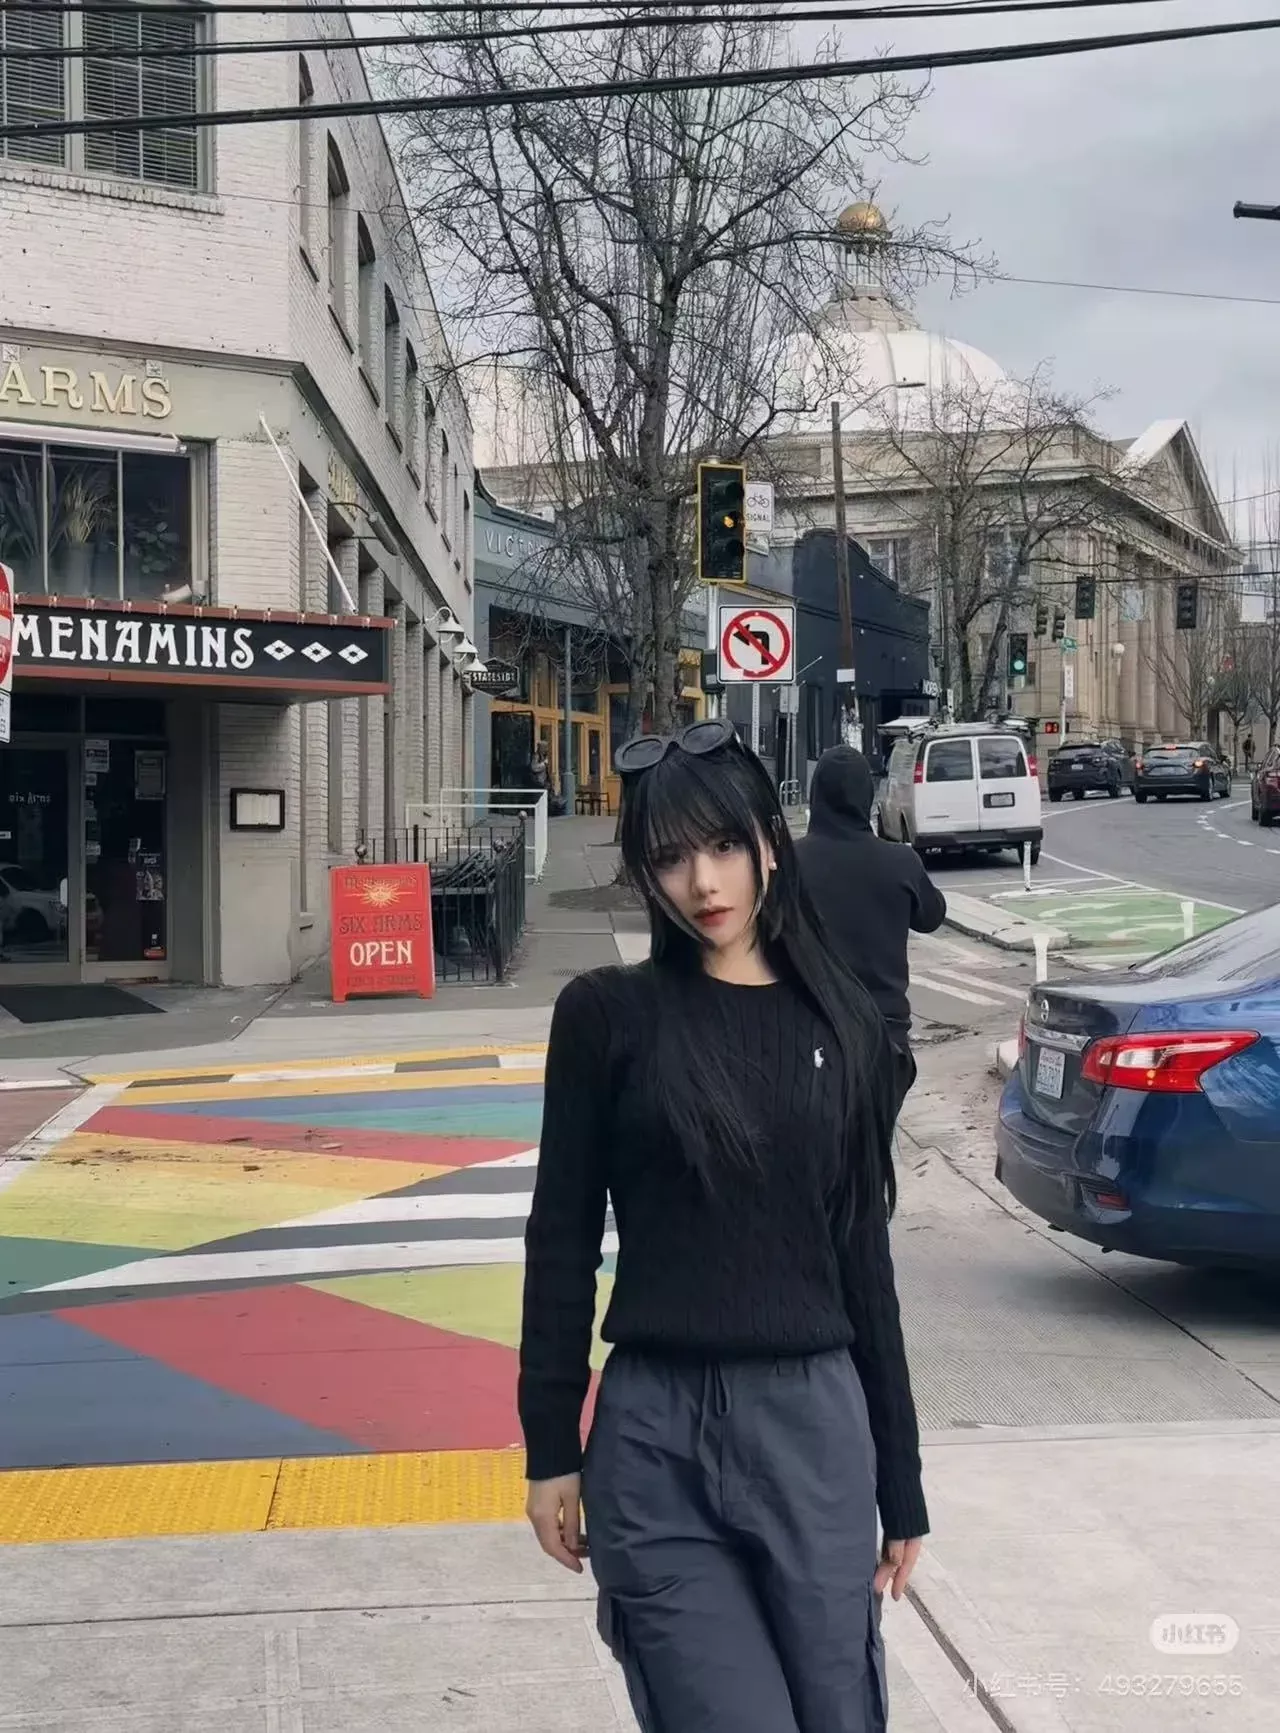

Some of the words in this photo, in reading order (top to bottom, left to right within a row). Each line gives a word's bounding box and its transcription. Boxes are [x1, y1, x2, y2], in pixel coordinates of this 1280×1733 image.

[0, 361, 173, 418] ARMS
[746, 512, 770, 522] SIGNAL
[13, 614, 255, 670] MENAMINS
[340, 914, 366, 934] SIX
[350, 940, 413, 967] OPEN
